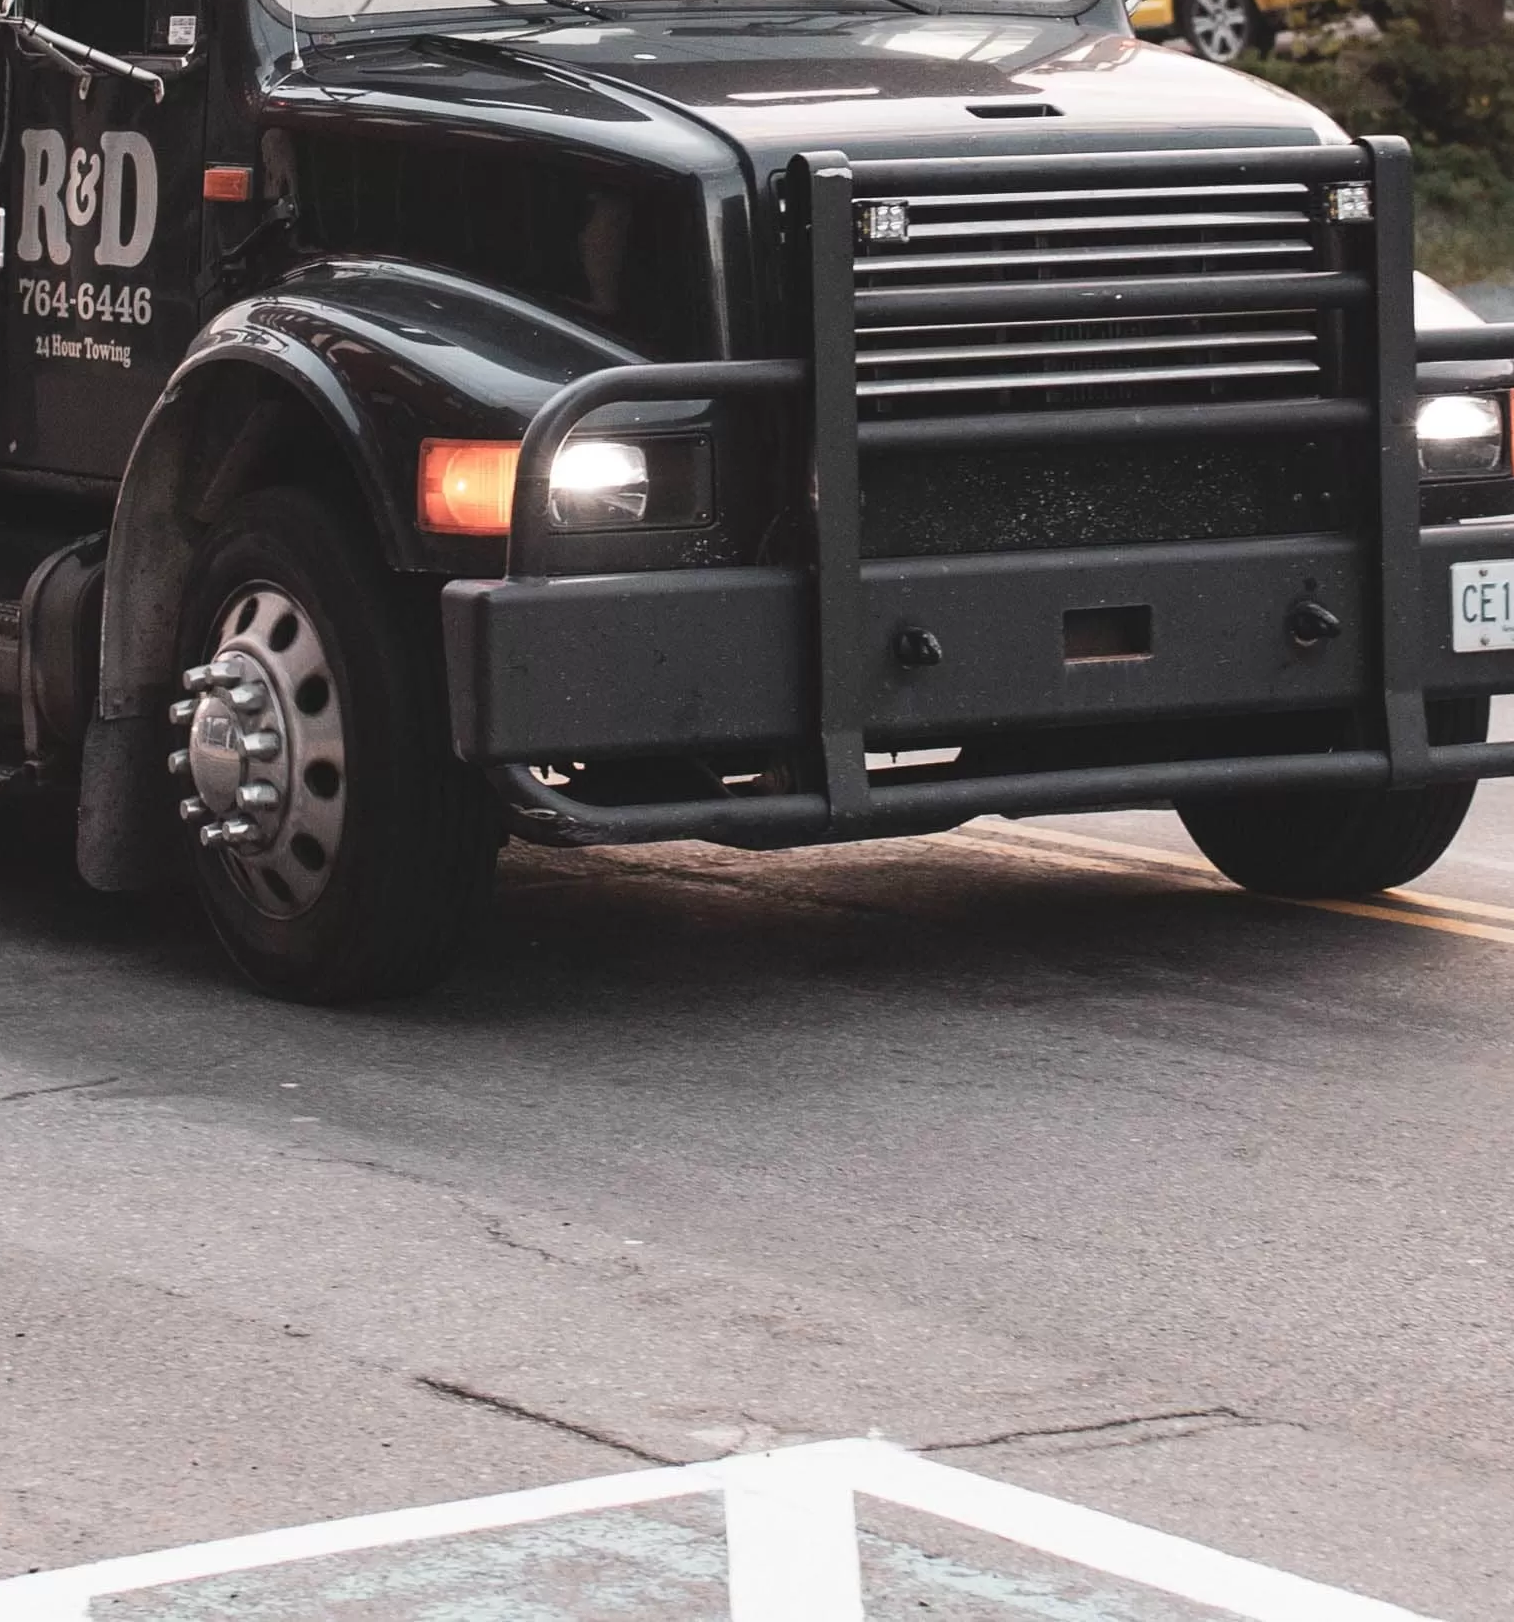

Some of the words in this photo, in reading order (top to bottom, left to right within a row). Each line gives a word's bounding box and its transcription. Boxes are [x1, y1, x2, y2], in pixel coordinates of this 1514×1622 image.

[17, 128, 158, 267] R&D
[18, 277, 152, 325] 764-6446
[35, 336, 50, 359] 24
[51, 334, 83, 359] Hour
[84, 337, 131, 368] Towing
[1462, 581, 1510, 623] CE1
